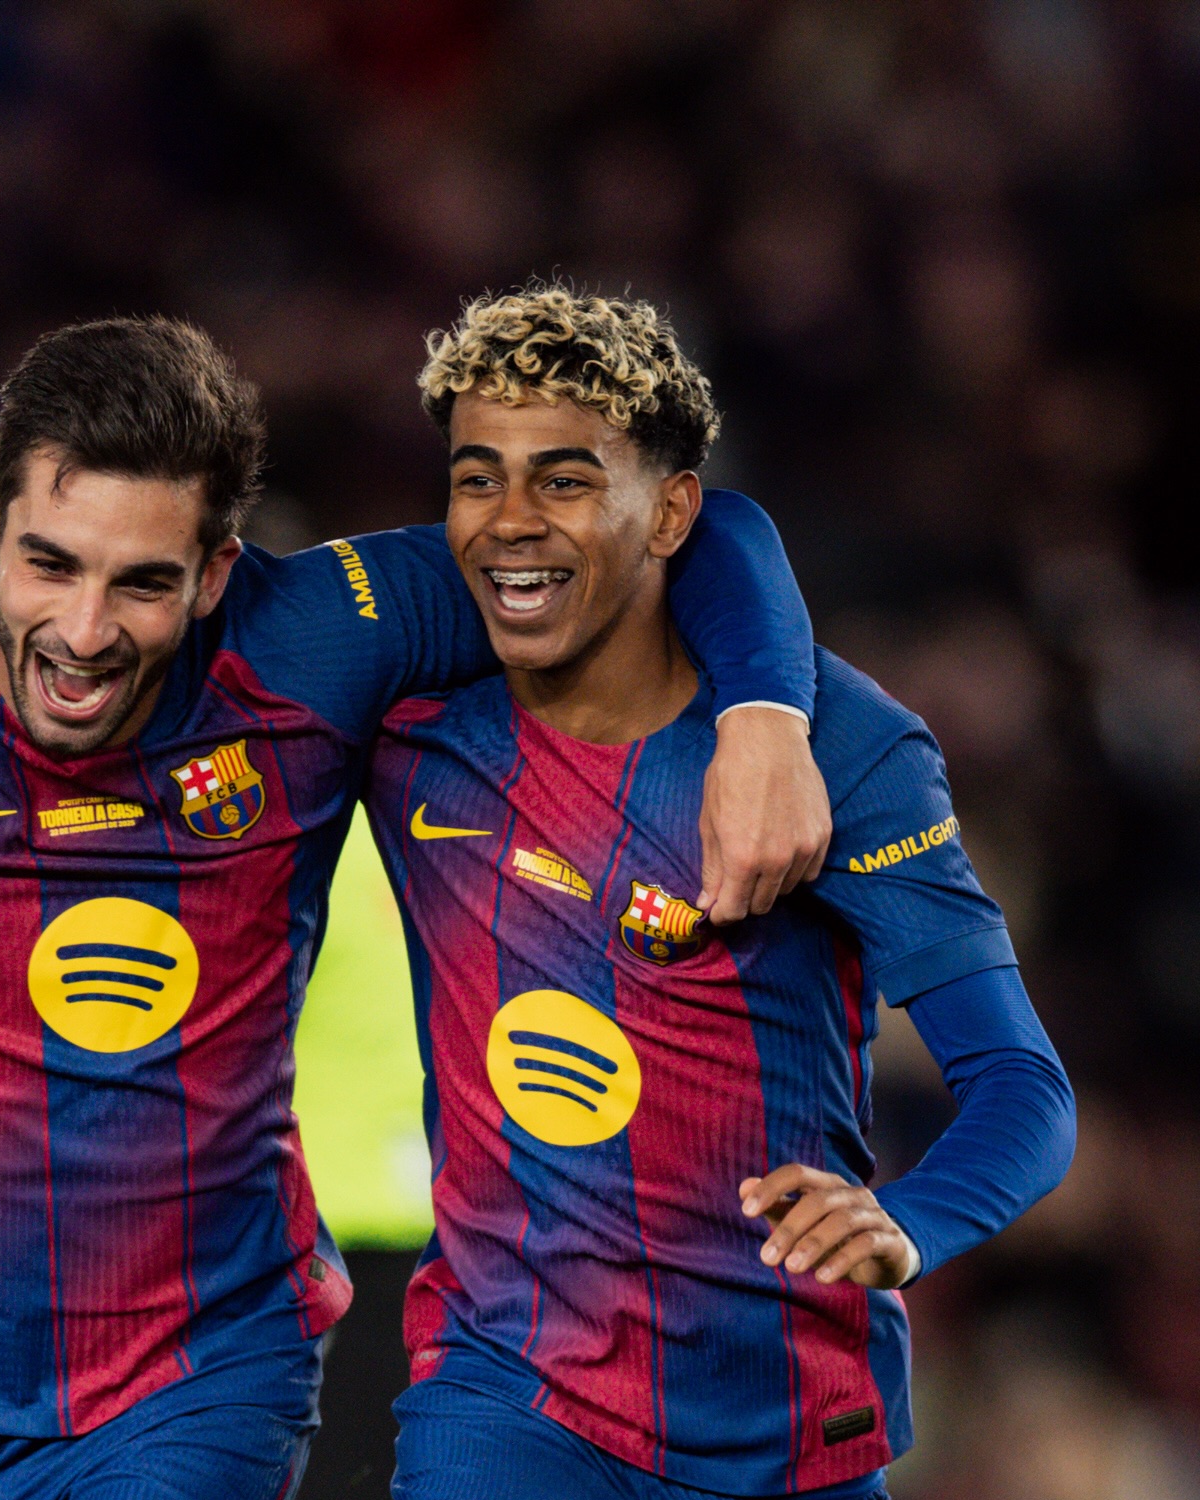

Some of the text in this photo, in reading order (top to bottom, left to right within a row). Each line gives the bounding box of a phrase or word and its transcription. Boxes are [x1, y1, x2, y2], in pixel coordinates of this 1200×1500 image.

[331, 541, 379, 620] AMBILIG
[206, 782, 238, 804] FCB
[38, 803, 145, 829] TORNEM A CASA
[849, 816, 956, 873] AMBILIGHT
[512, 848, 563, 881] TORNEM
[561, 867, 571, 885] A
[644, 924, 674, 942] FCB
